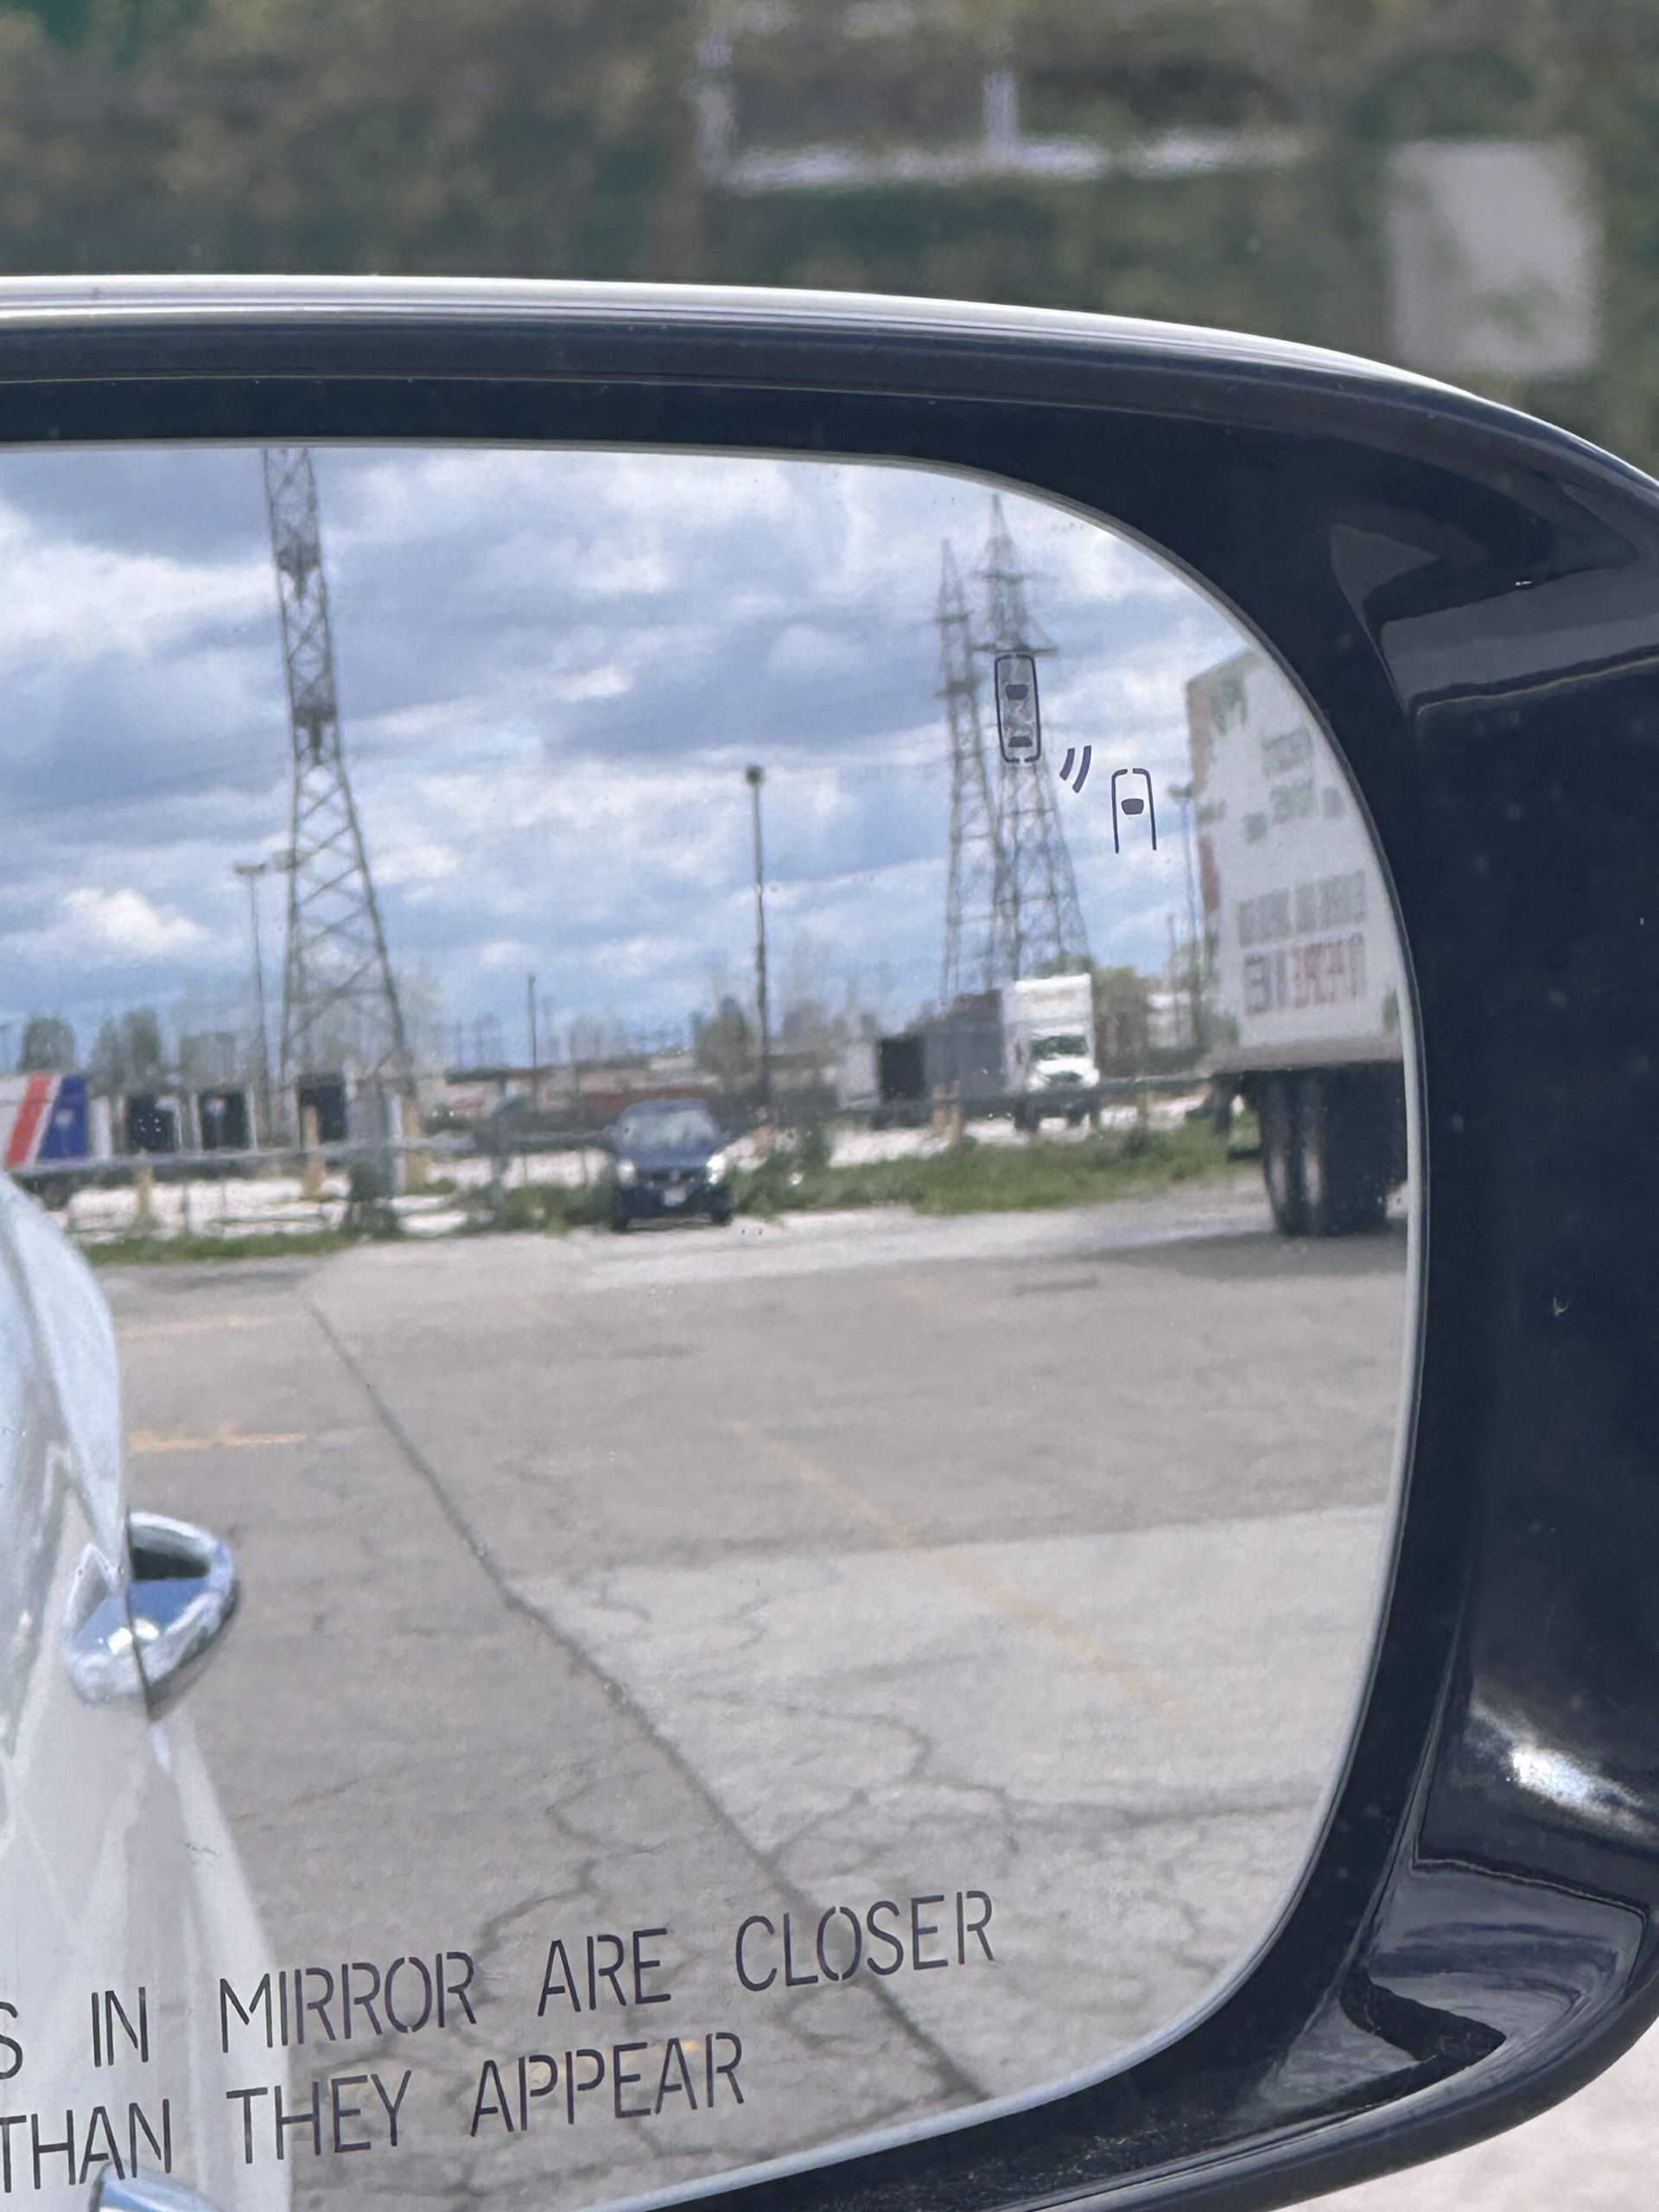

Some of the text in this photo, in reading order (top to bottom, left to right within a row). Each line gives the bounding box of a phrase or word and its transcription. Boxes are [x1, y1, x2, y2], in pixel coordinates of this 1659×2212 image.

[92, 1986, 149, 2068] IN
[219, 1951, 477, 2053] MIRROR
[537, 1927, 671, 2017] ARE
[735, 1890, 995, 1992] CLOSER
[0, 2031, 744, 2193] THAN THEY APPEAR
